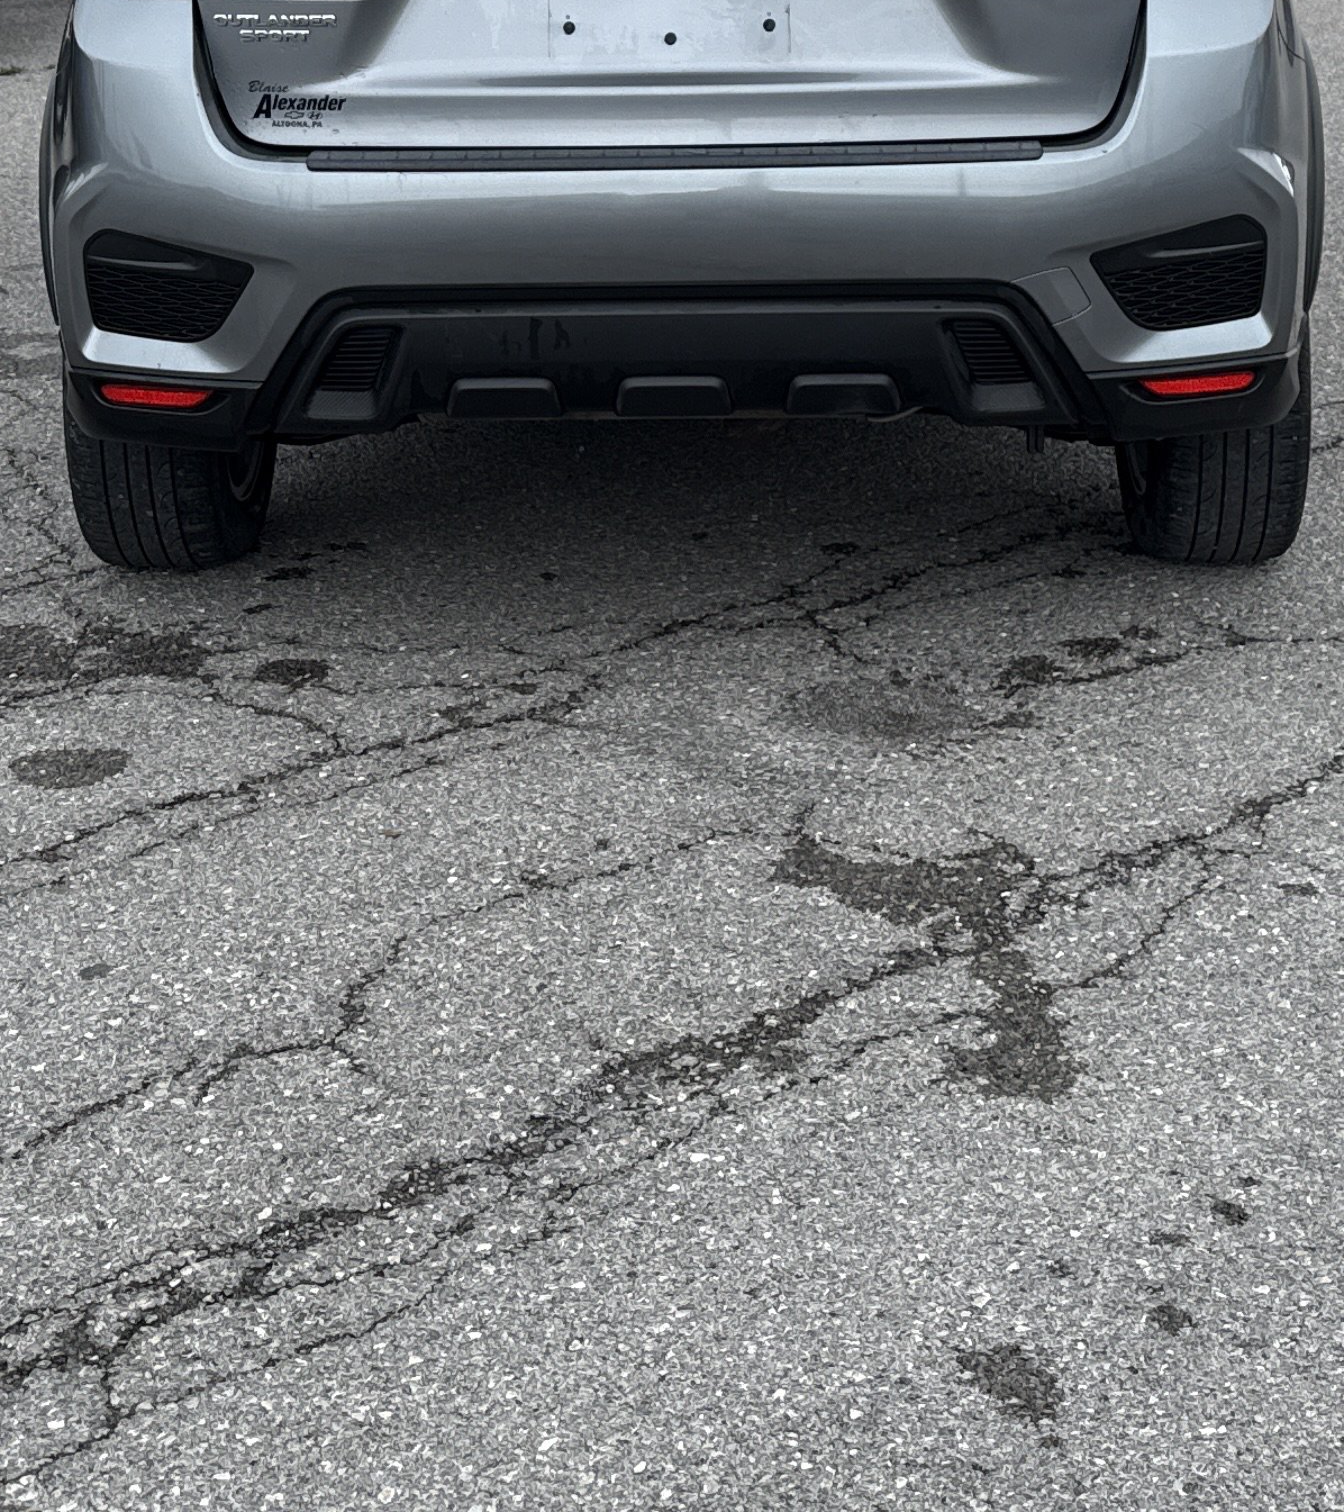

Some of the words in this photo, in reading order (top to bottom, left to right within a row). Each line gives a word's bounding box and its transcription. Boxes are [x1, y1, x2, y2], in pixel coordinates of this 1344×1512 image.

[213, 14, 337, 27] OUTLANDER
[239, 29, 310, 42] SPORT
[248, 80, 289, 93] Blaise
[252, 93, 346, 119] Alexander
